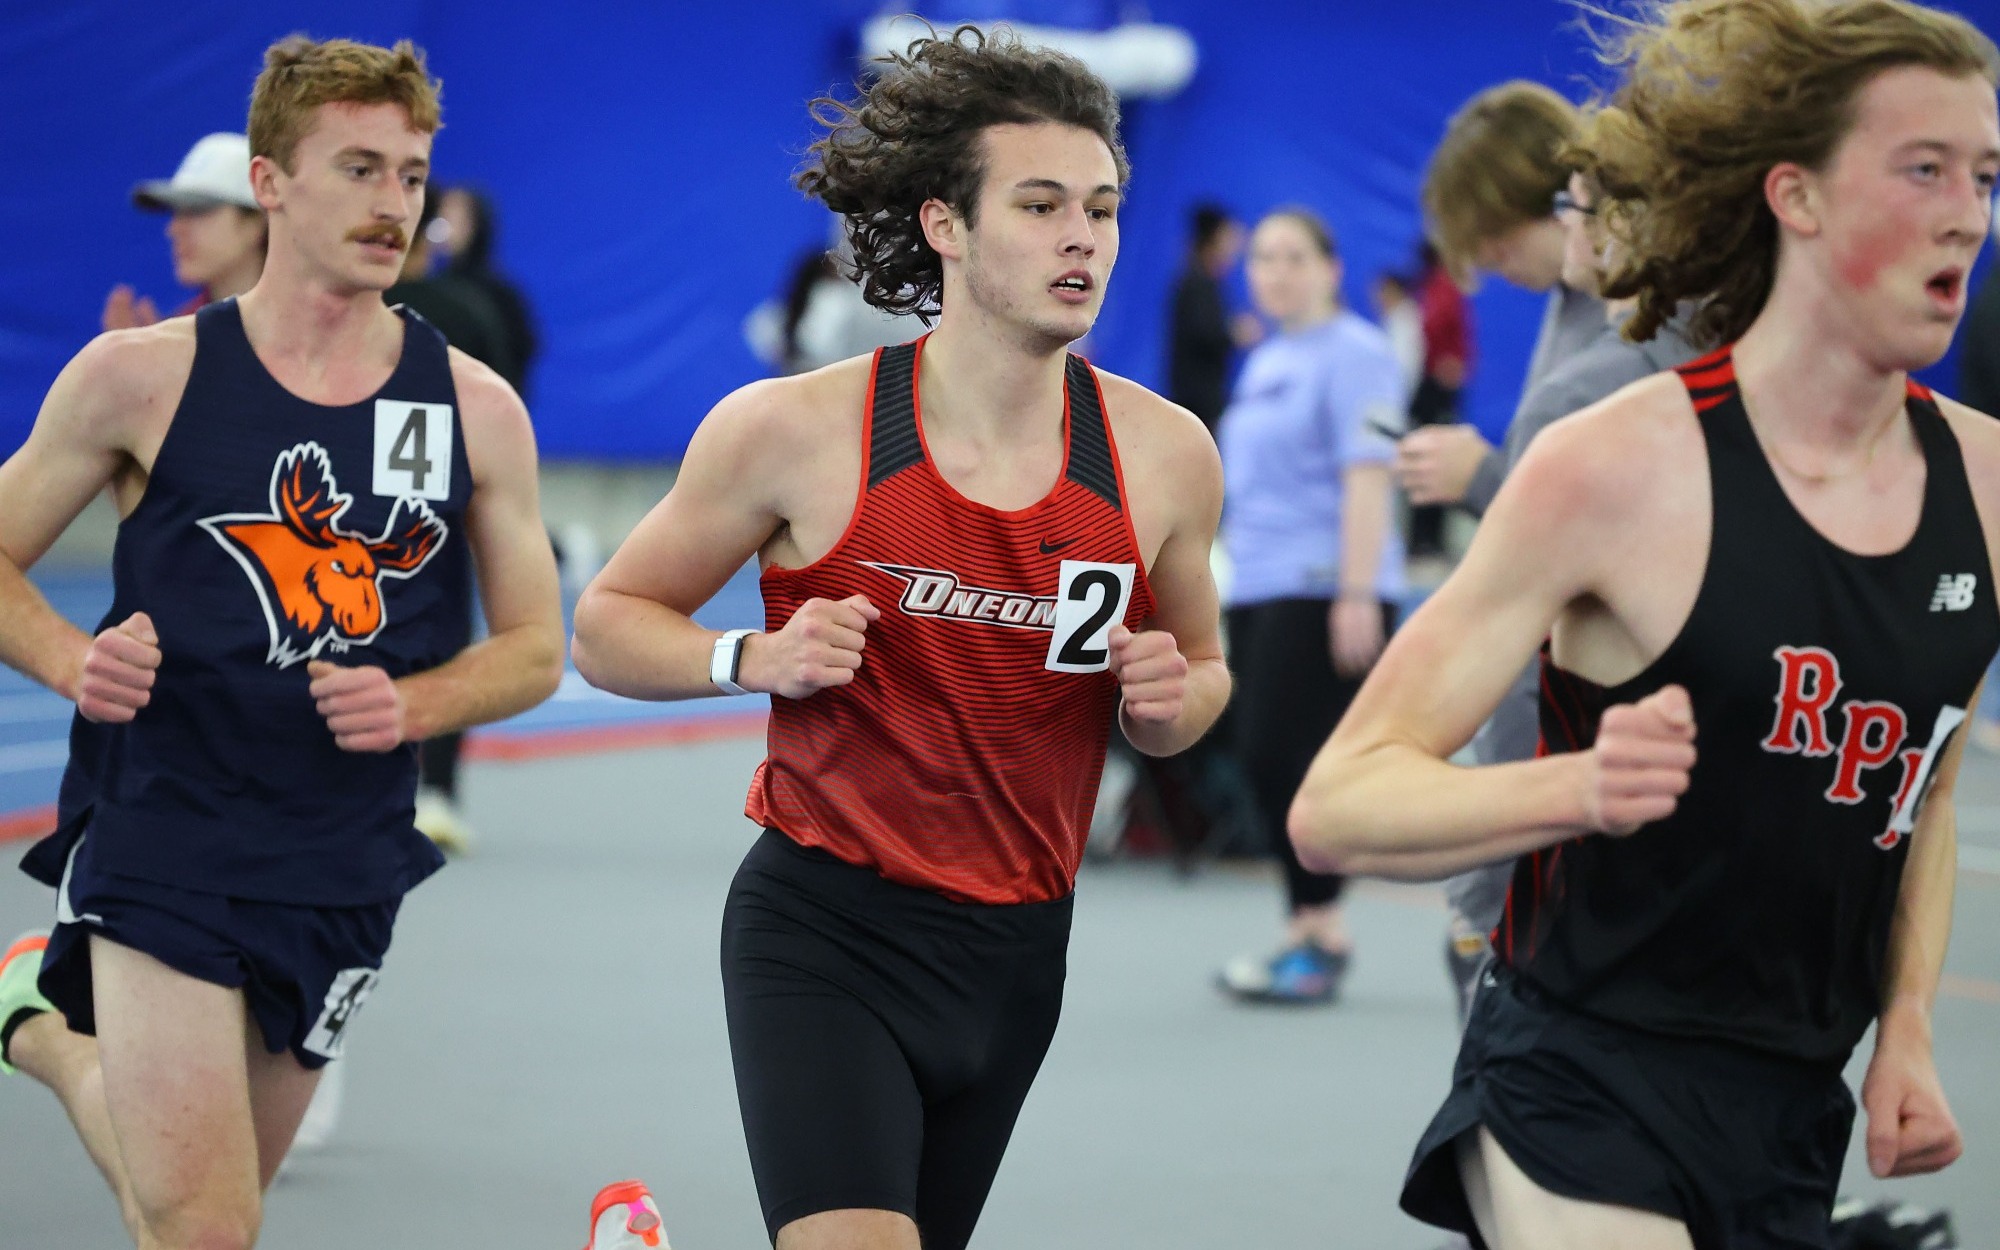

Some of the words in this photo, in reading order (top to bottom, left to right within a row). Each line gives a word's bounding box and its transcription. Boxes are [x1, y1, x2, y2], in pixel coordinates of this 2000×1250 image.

[388, 407, 432, 490] 4
[1057, 570, 1121, 664] 2
[1929, 573, 1977, 612] NB
